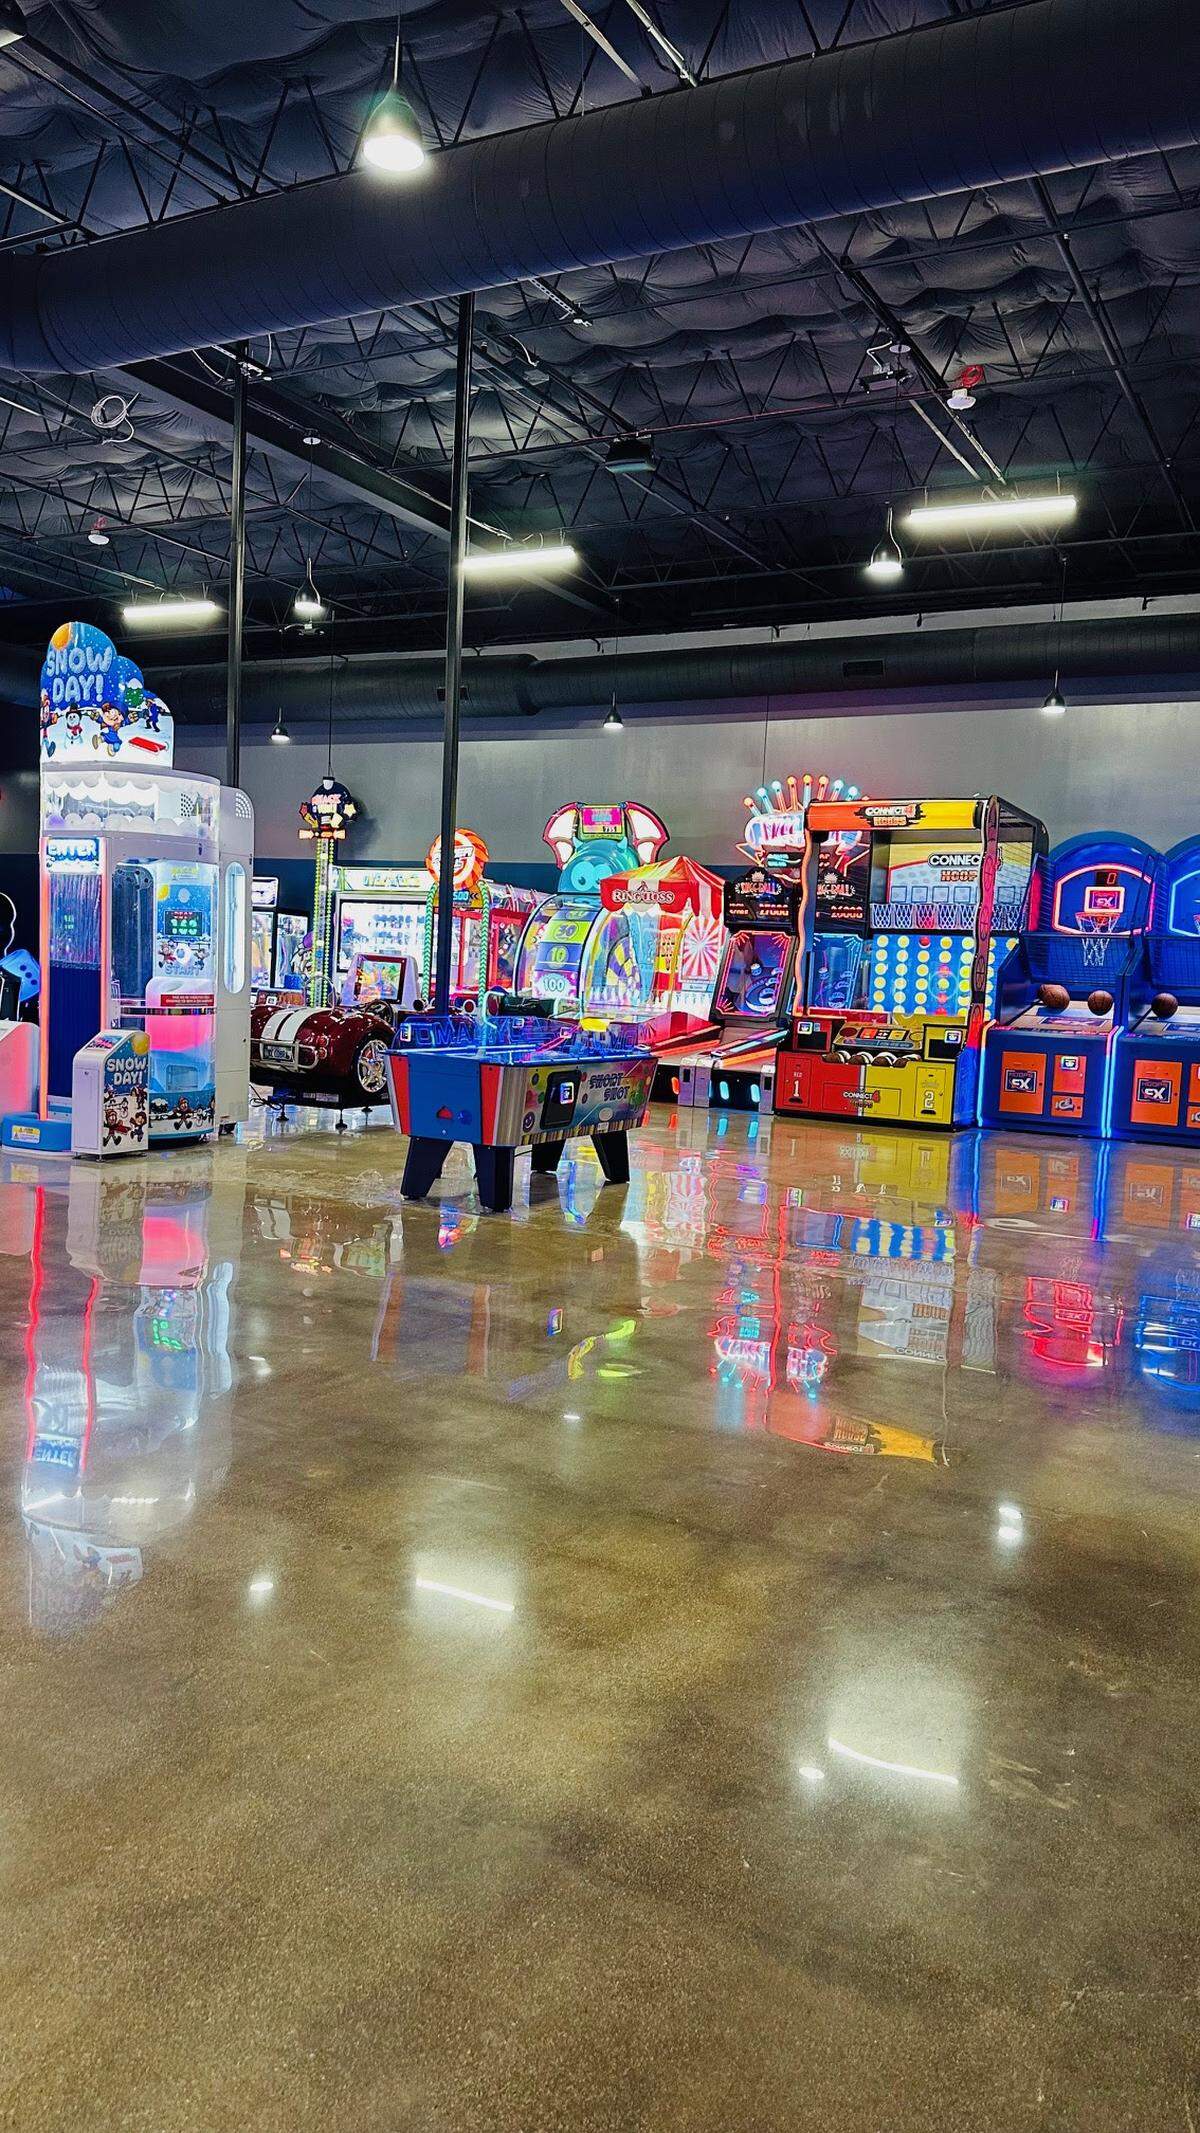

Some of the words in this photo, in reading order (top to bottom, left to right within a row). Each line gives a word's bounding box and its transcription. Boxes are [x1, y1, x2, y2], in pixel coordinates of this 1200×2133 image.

[46, 646, 112, 677] SNOW
[52, 674, 104, 703] DAY!
[929, 854, 981, 866] CONNEC
[940, 869, 978, 881] HOOP
[612, 888, 641, 904] RING
[641, 890, 676, 905] TOSS
[542, 977, 565, 992] 100
[106, 1057, 147, 1073] SNOW
[113, 1071, 143, 1086] DAY!
[589, 1072, 624, 1090] SHORT
[603, 1086, 631, 1102] SHOT
[842, 1090, 872, 1101] CONNECT
[924, 1089, 935, 1108] 2
